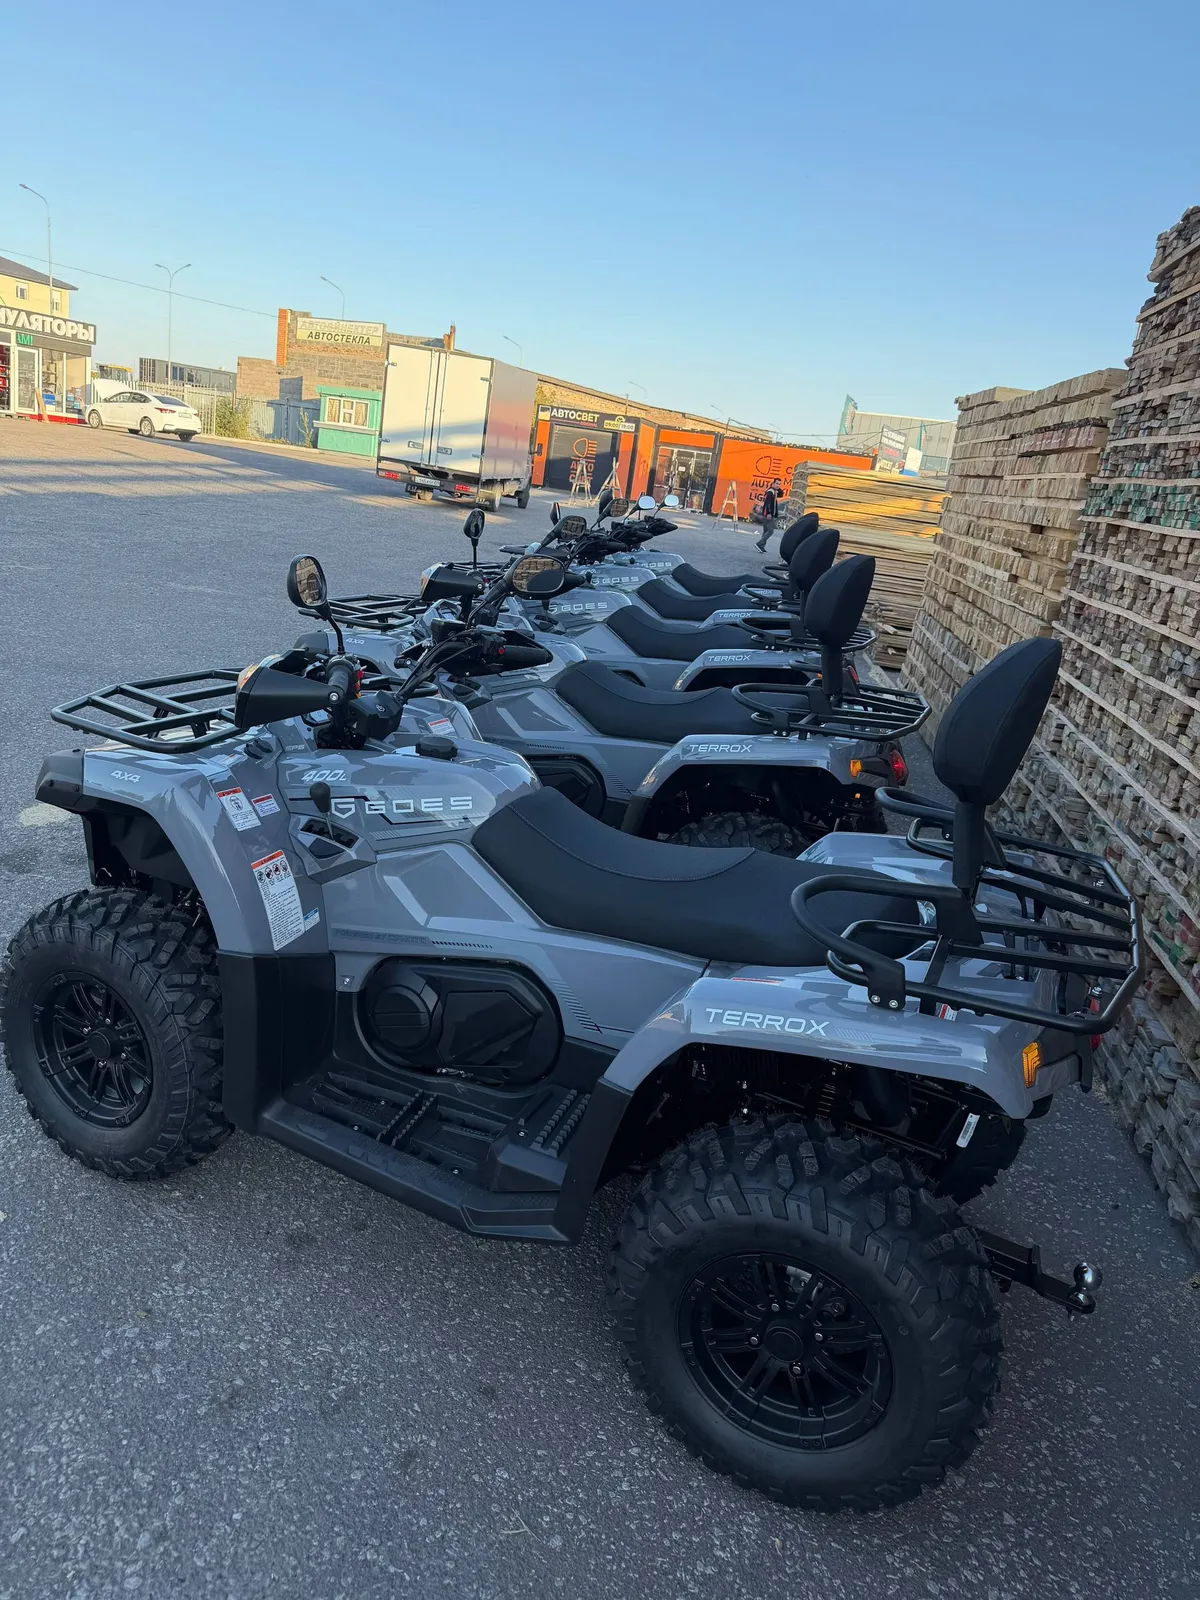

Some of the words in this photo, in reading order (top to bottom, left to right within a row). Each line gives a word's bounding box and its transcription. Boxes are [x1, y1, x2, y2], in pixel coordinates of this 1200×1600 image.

[307, 331, 371, 345] АВТОСТЕКЛА
[551, 408, 600, 423] АВТОСВЕТ
[751, 479, 772, 489] AUT
[561, 602, 608, 612] GOES
[708, 654, 751, 662] TERROX
[689, 744, 753, 753] TERROX
[364, 796, 473, 815] GOES
[705, 1007, 830, 1037] TERROX
